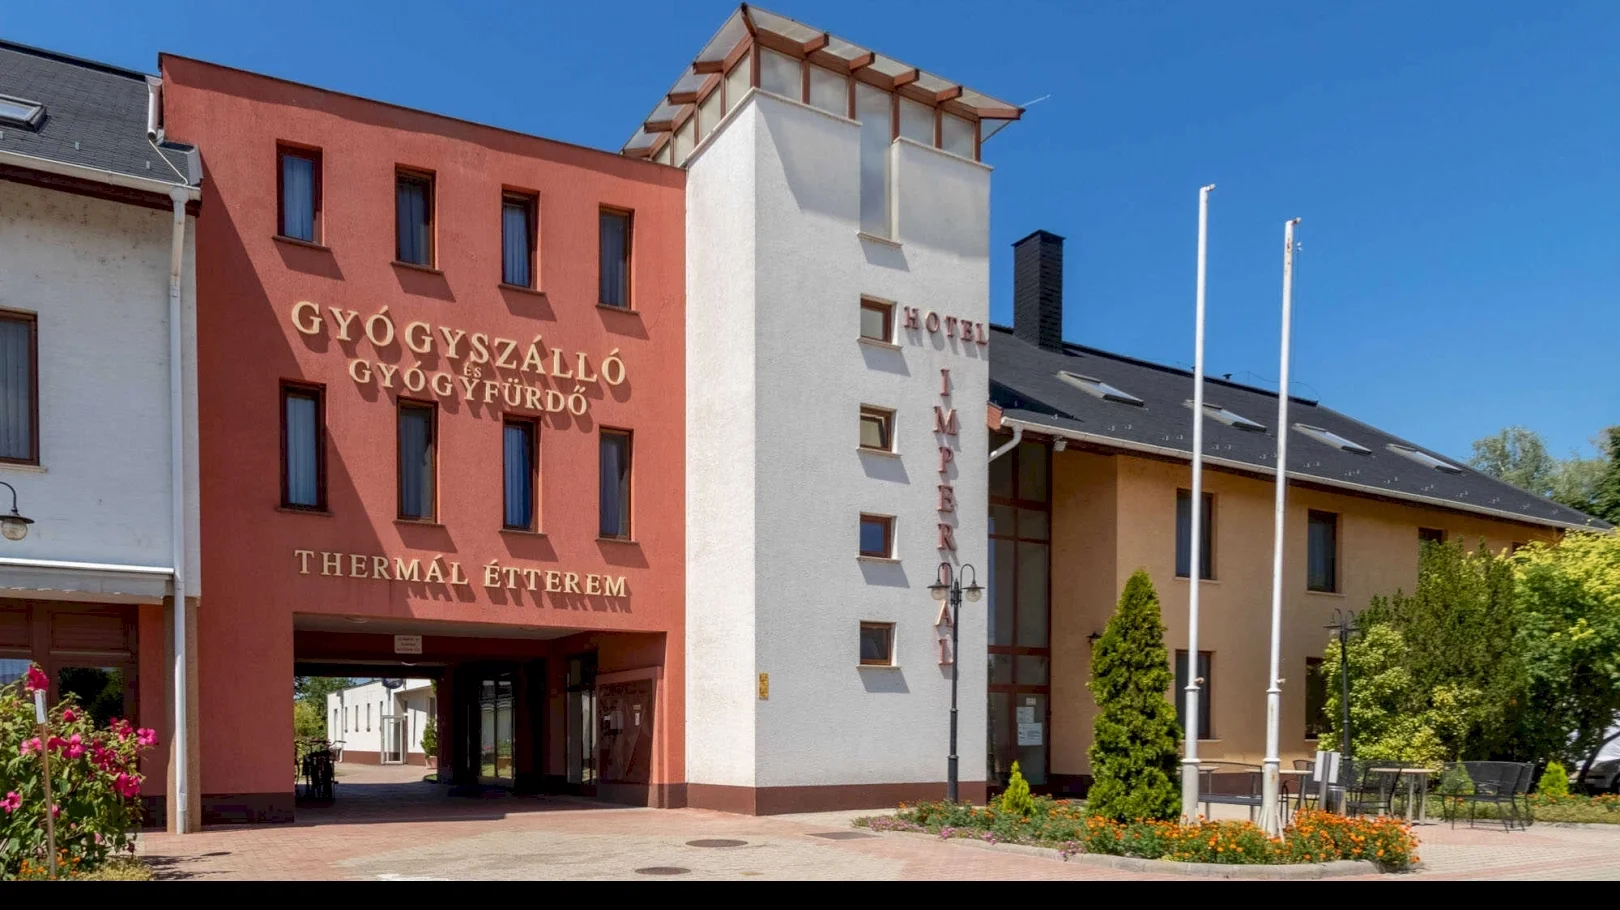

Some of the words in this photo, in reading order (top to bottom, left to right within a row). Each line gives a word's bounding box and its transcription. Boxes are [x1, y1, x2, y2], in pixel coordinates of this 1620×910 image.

[291, 301, 626, 386] GYÓGYSZÁLLÓ
[903, 306, 988, 345] HOTEL
[349, 359, 588, 416] GYÓGYFÜRDŐ
[463, 362, 482, 379] ÉS
[933, 368, 958, 665] IMPERIAL
[294, 550, 469, 586] THERMÁL
[483, 558, 627, 598] ÉTTEREM
